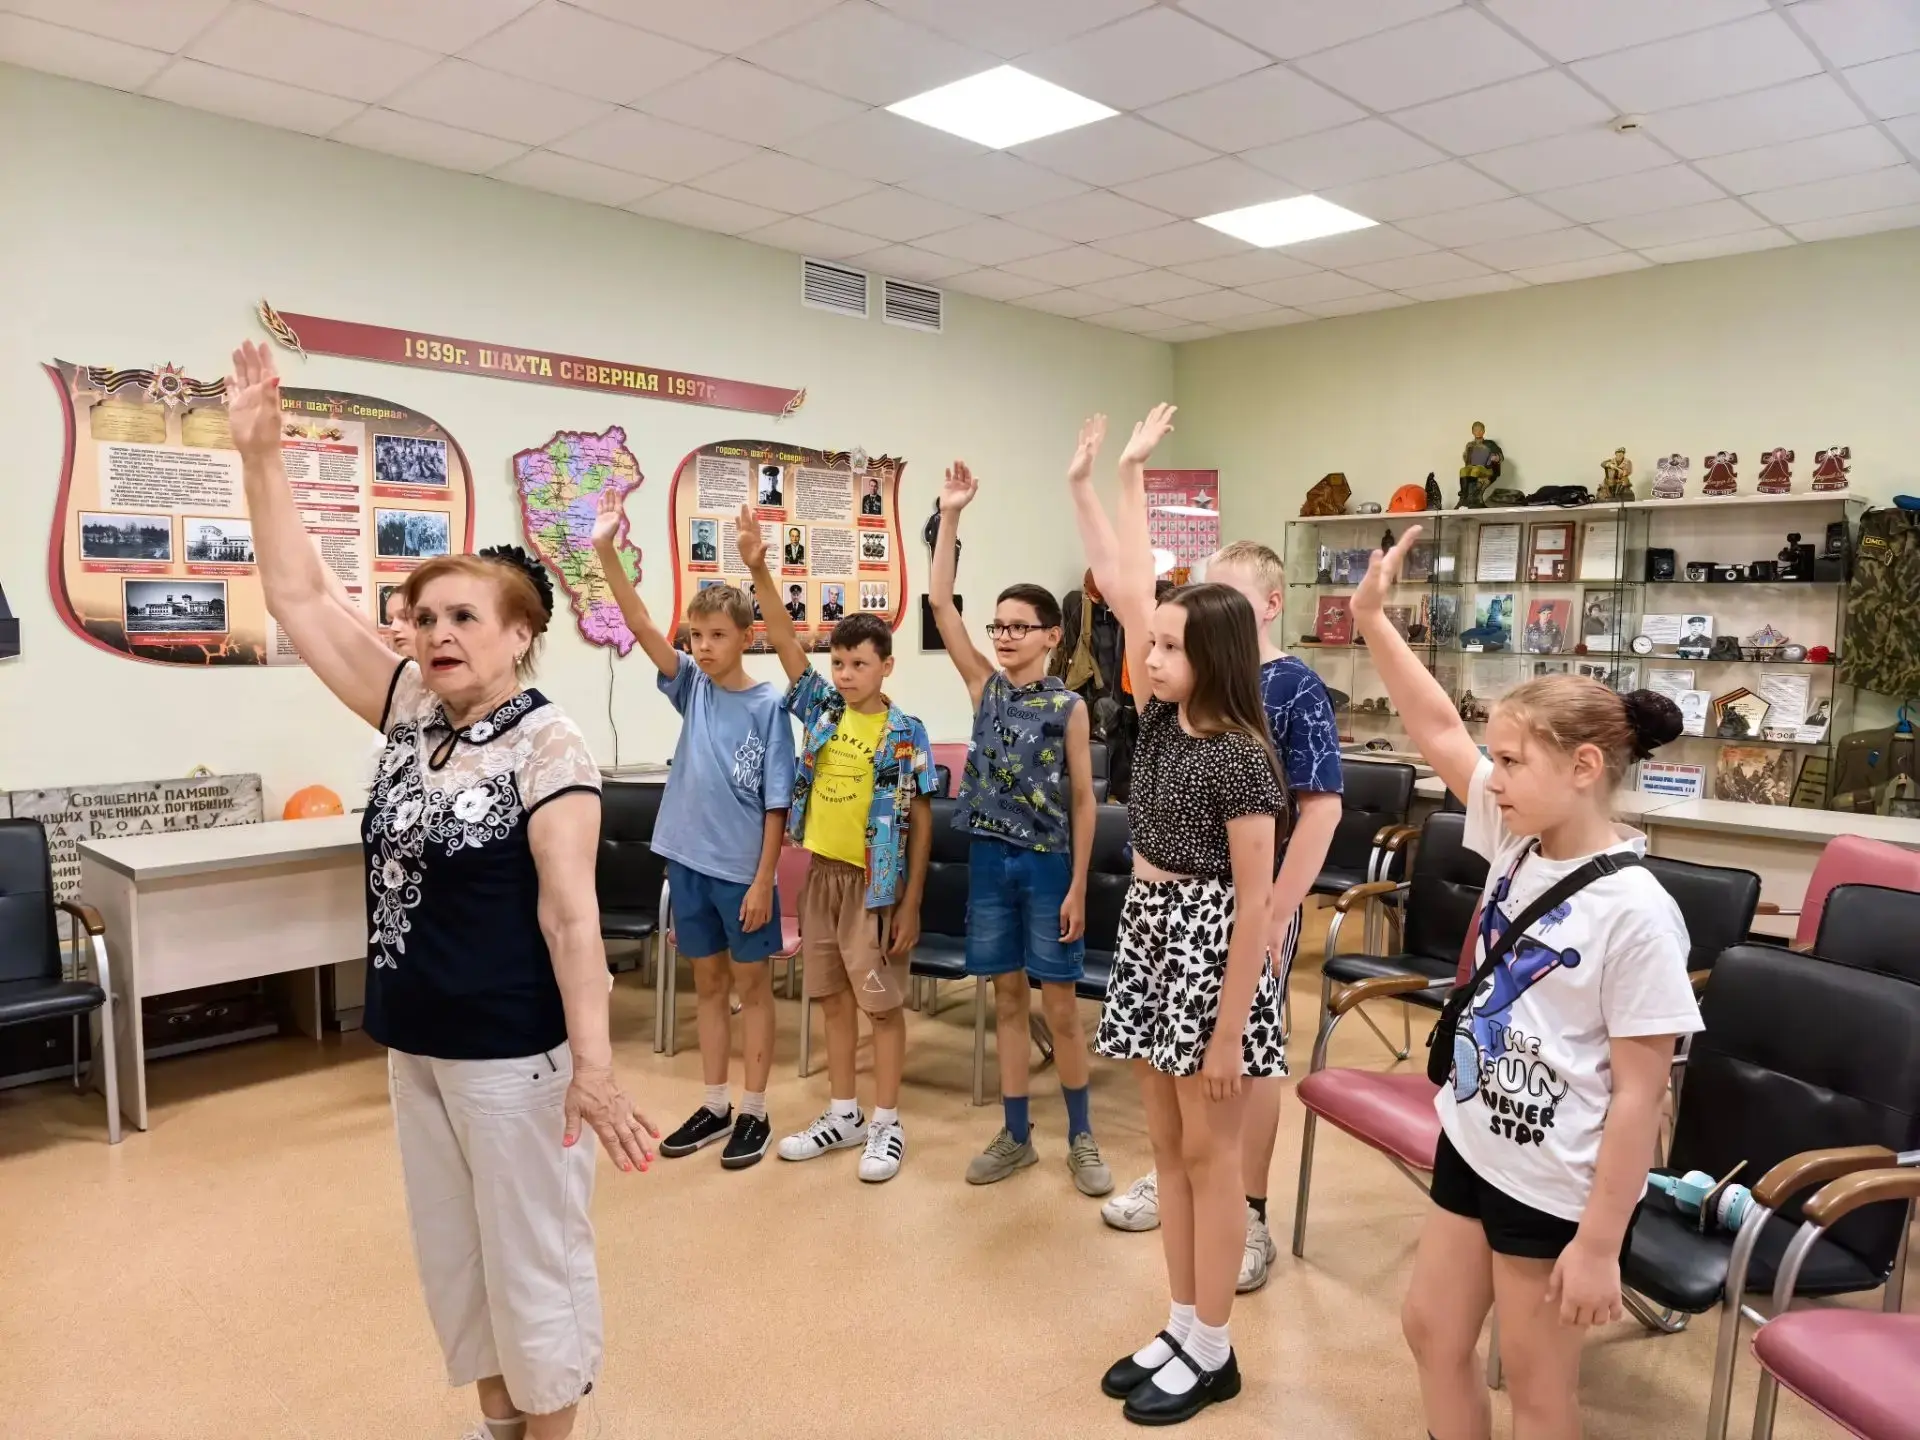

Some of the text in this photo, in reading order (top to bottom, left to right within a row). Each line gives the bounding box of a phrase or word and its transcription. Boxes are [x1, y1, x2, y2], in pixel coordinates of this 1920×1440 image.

[404, 337, 718, 399] 1939г. ШАХТА СЕВЕРНАЯ 1997г.
[281, 398, 408, 420] рия шахты «Северная»
[830, 733, 874, 764] OOKLYN
[1488, 1019, 1542, 1055] THE
[1480, 1048, 1569, 1101] FUN
[1481, 1088, 1556, 1128] NEVER
[1489, 1114, 1545, 1147] STOP
